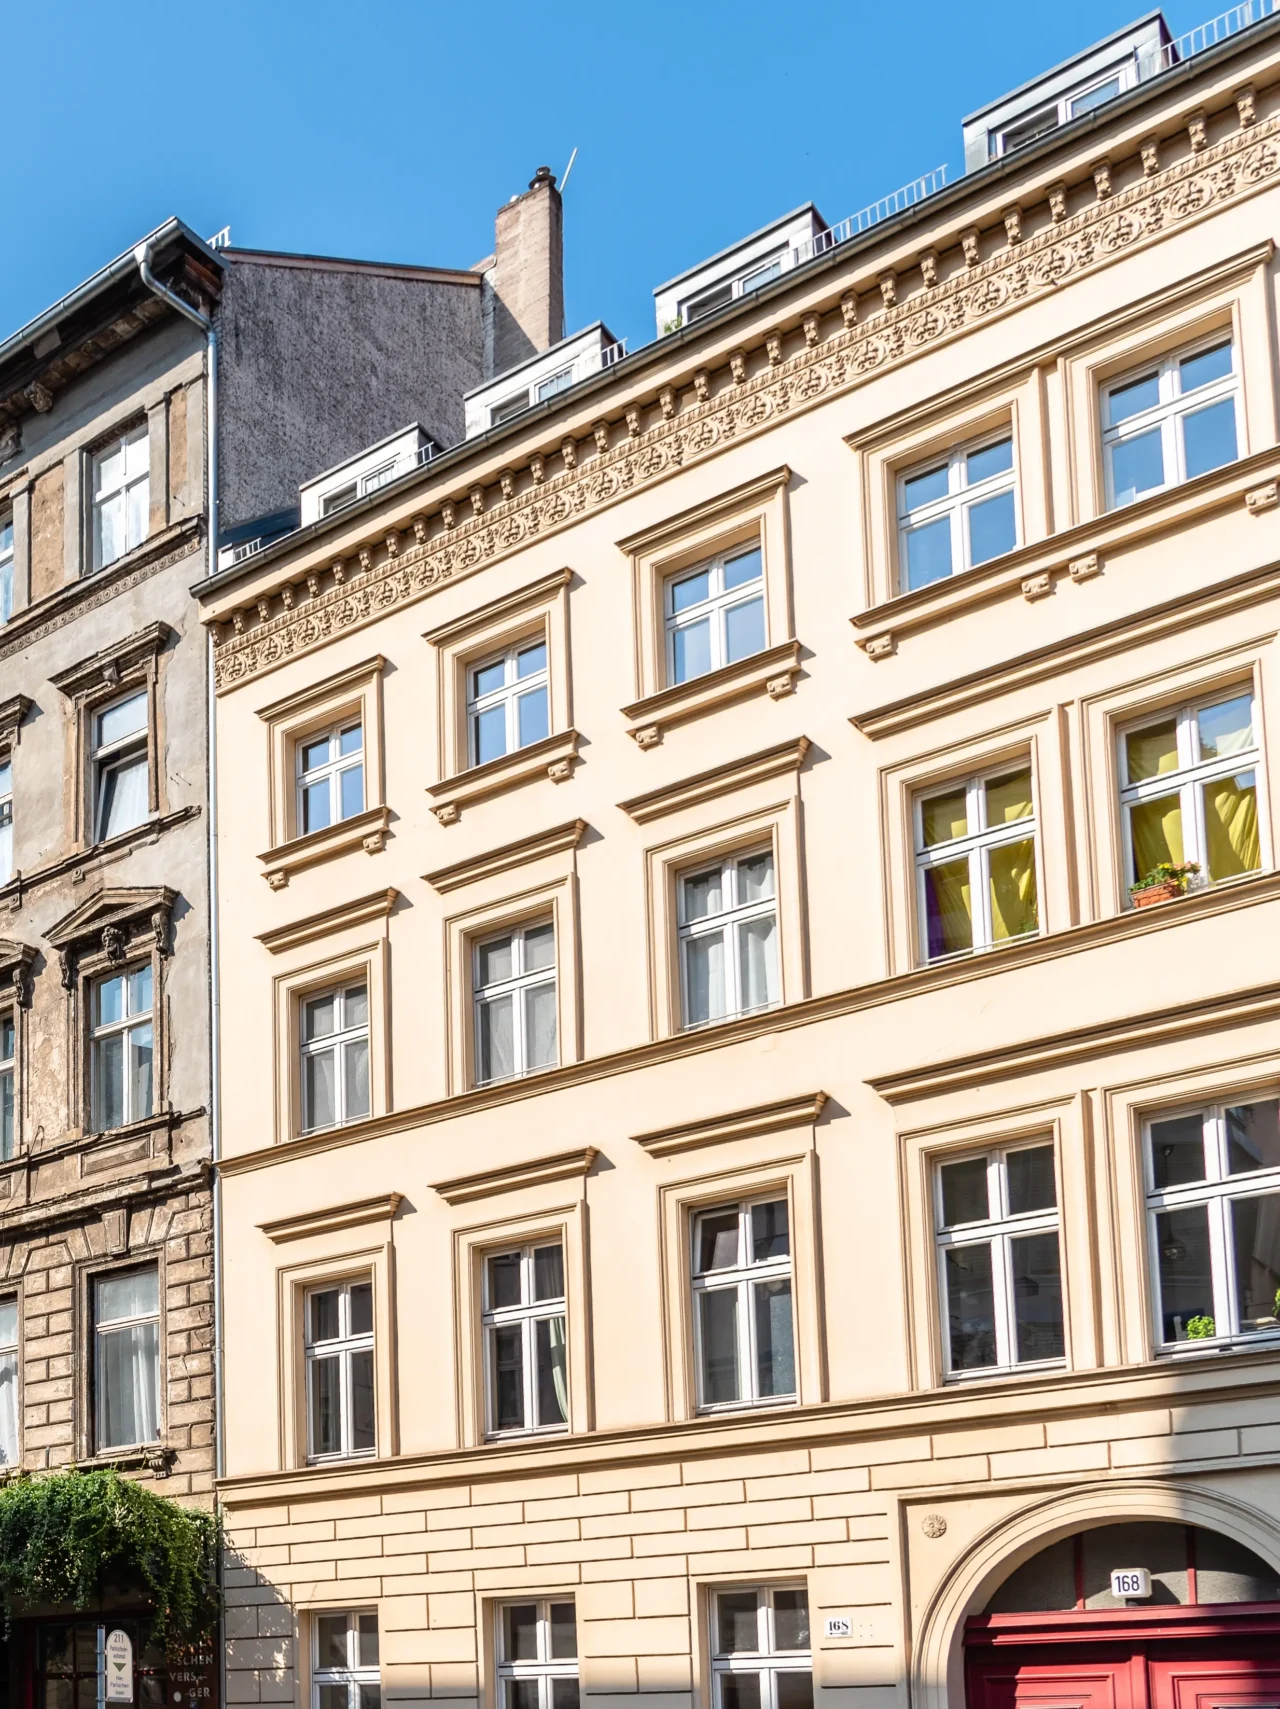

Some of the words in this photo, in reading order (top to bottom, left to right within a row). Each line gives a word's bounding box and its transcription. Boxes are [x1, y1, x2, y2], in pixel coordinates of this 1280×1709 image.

[1114, 1574, 1141, 1593] 168
[828, 1620, 850, 1632] 168
[113, 1633, 125, 1644] 211
